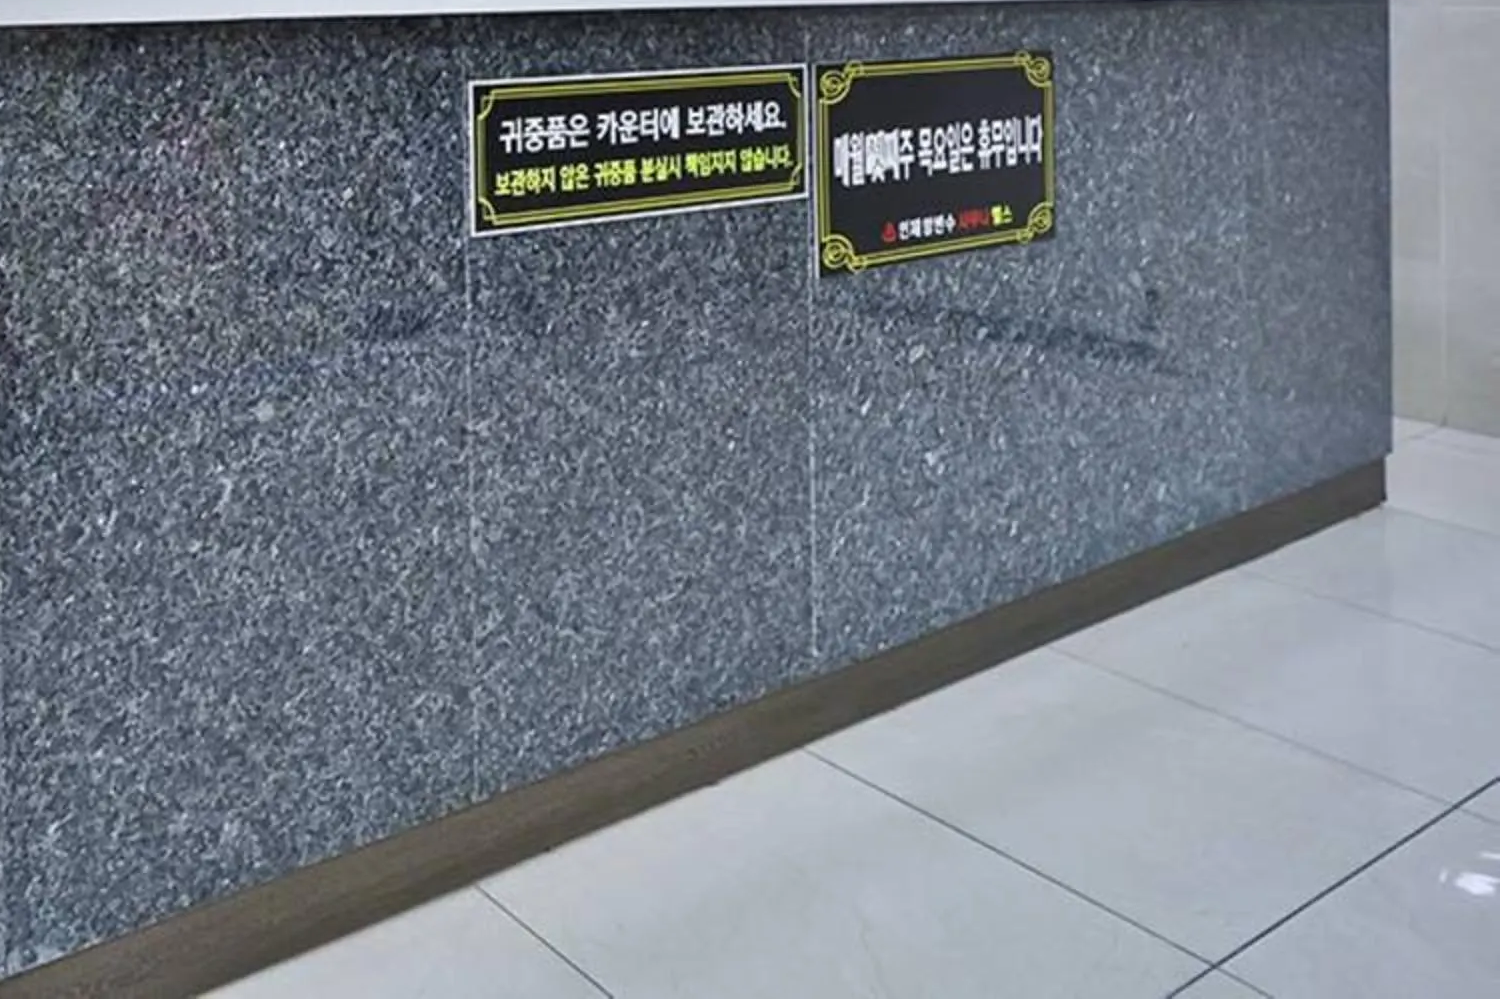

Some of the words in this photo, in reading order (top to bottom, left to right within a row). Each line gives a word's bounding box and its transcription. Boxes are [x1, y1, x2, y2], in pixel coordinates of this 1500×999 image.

[499, 113, 589, 154] 귀중품은
[596, 106, 680, 145] 카운터에
[685, 101, 787, 136] 보관하세요.
[917, 121, 975, 177] 목요일은
[978, 114, 1043, 169] 휴무입니다
[494, 166, 556, 196] 보관하지
[559, 164, 590, 191] 않은
[594, 158, 636, 188] 귀중품
[640, 153, 681, 183] 분실시
[685, 149, 737, 177] 책임지지
[740, 144, 794, 172] 않습니다.
